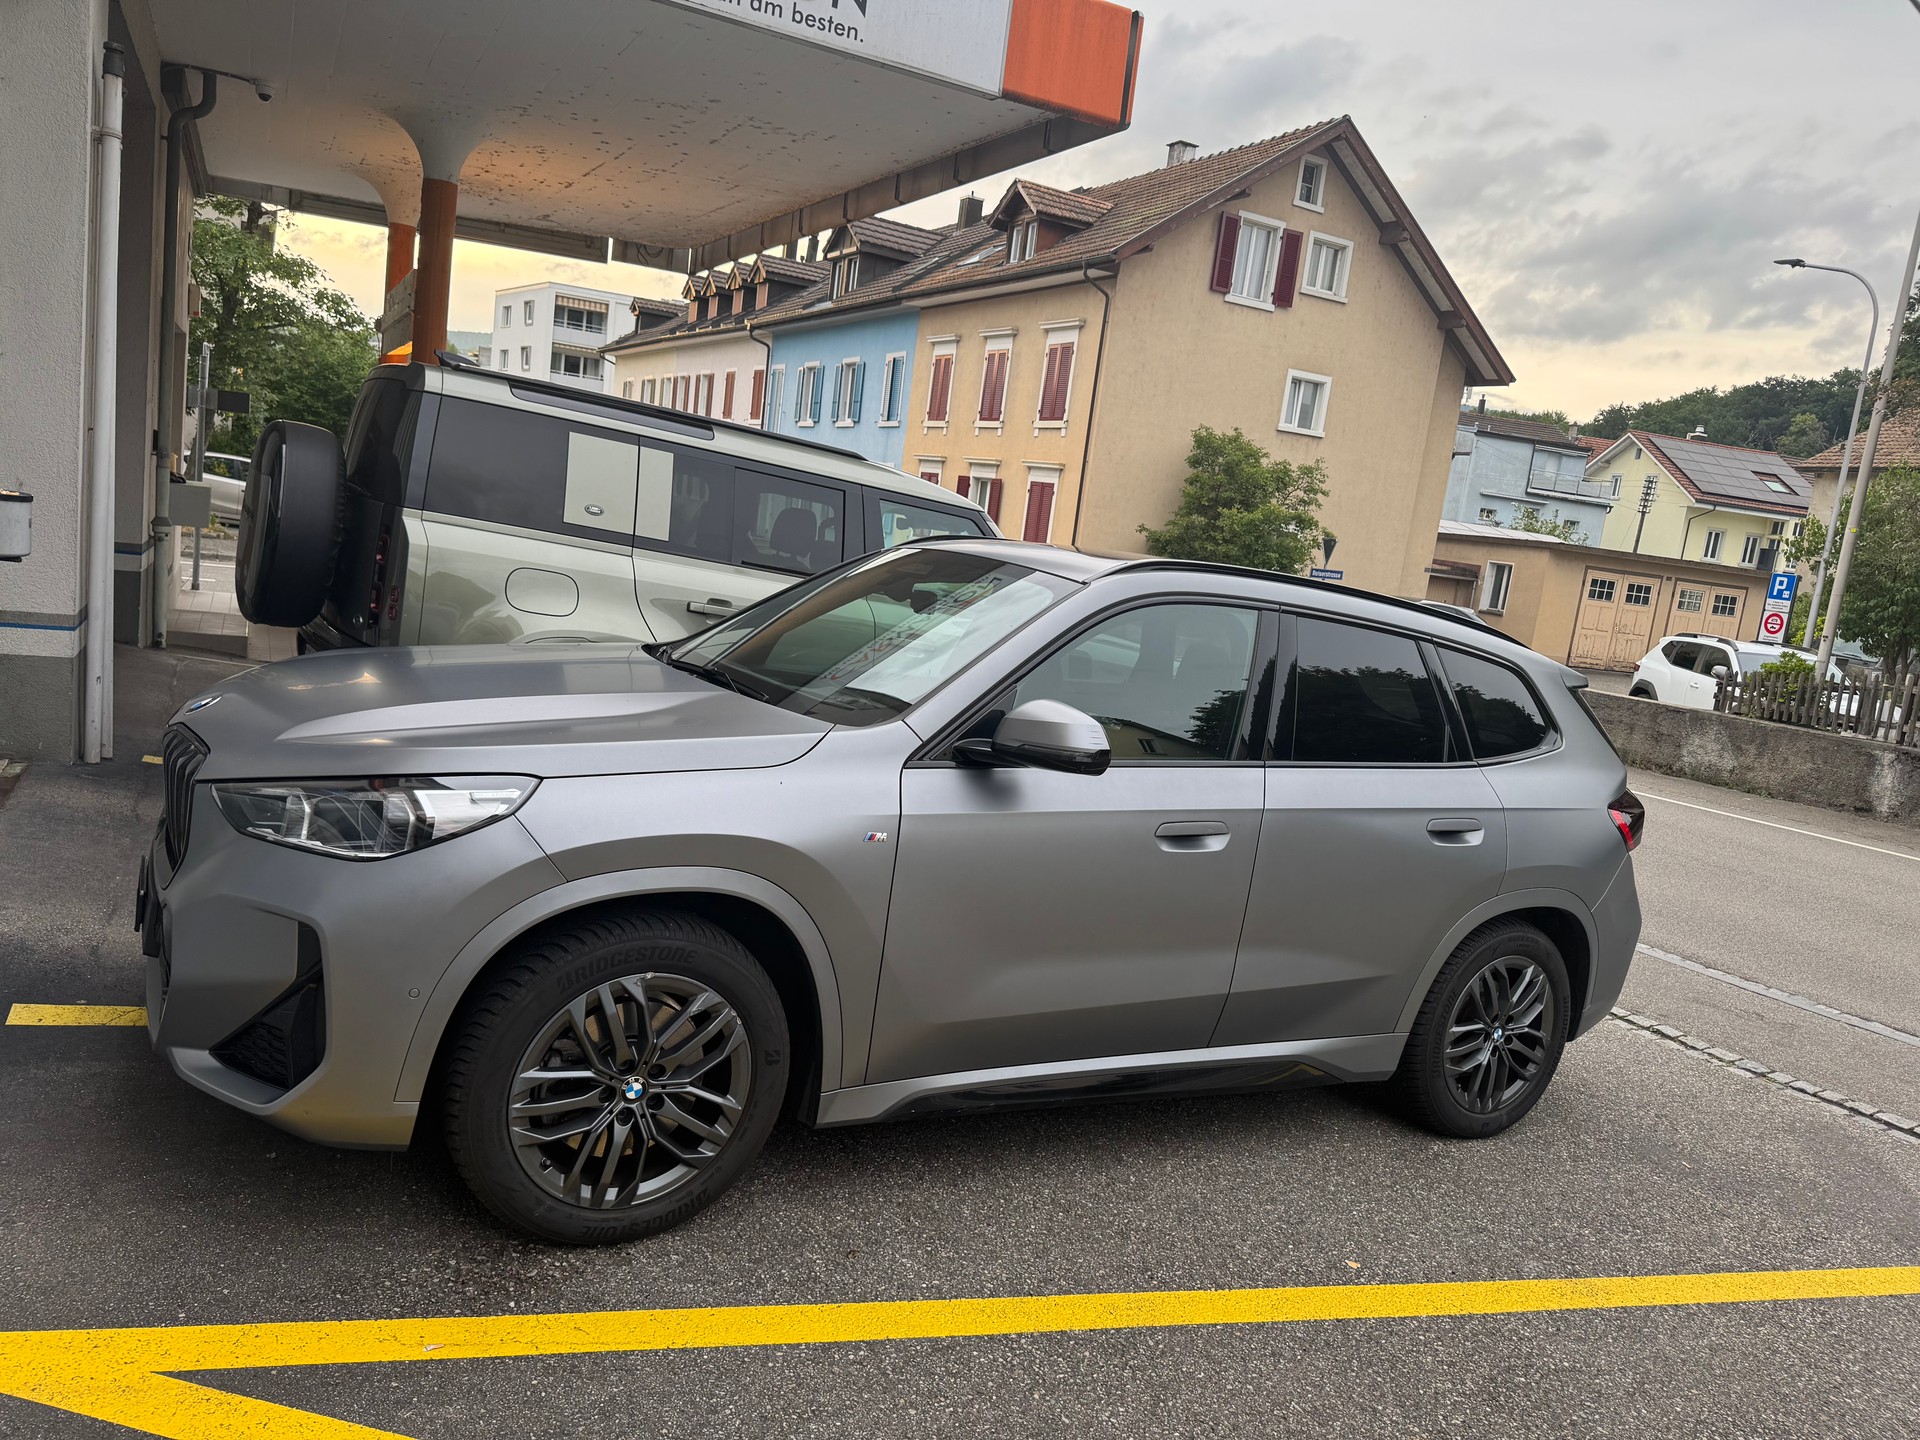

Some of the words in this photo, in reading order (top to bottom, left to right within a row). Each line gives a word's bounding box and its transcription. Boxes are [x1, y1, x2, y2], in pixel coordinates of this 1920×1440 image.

[750, 0, 784, 19] am
[791, 2, 864, 43] besten.
[1773, 576, 1788, 595] P
[556, 945, 698, 995] BRIDGESTONE
